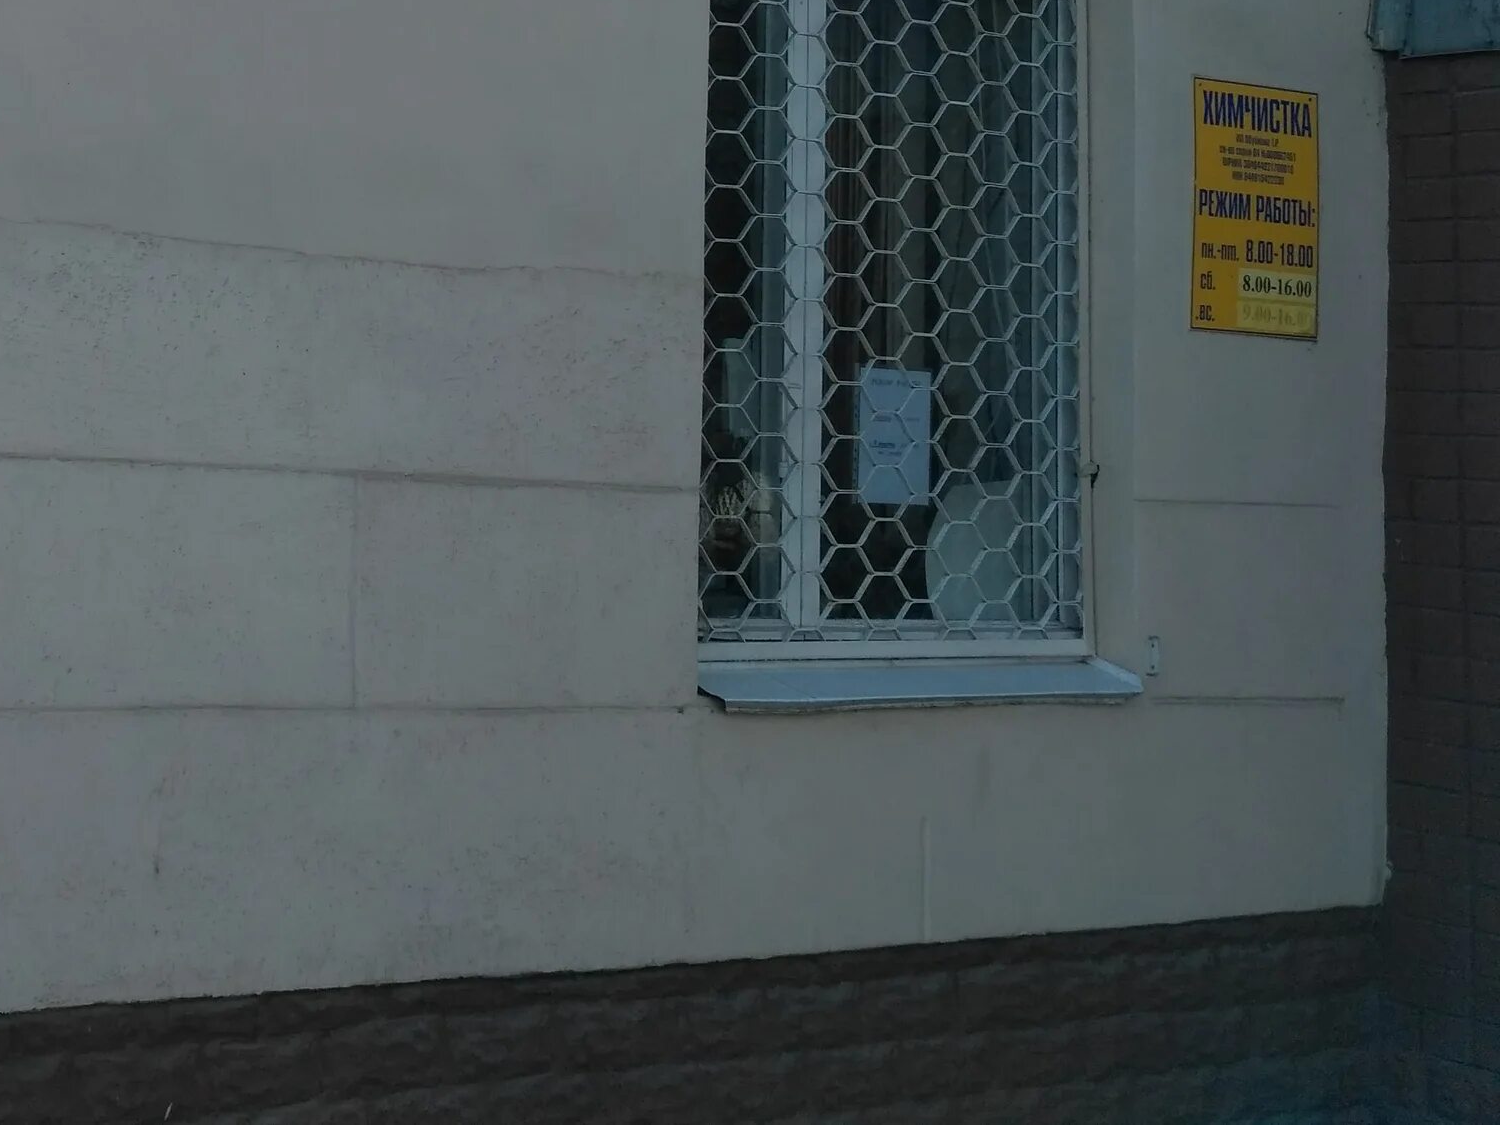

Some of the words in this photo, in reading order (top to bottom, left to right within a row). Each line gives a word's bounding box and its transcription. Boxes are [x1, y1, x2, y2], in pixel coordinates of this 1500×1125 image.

[1202, 89, 1312, 138] ХИМЧИСТКА
[1199, 188, 1251, 221] РЕЖИМ
[1255, 195, 1315, 228] РАБОТЫ:
[1245, 239, 1314, 269] 8.00-18.00
[1200, 270, 1216, 291] сб.
[1242, 274, 1312, 298] 8.00-16.00
